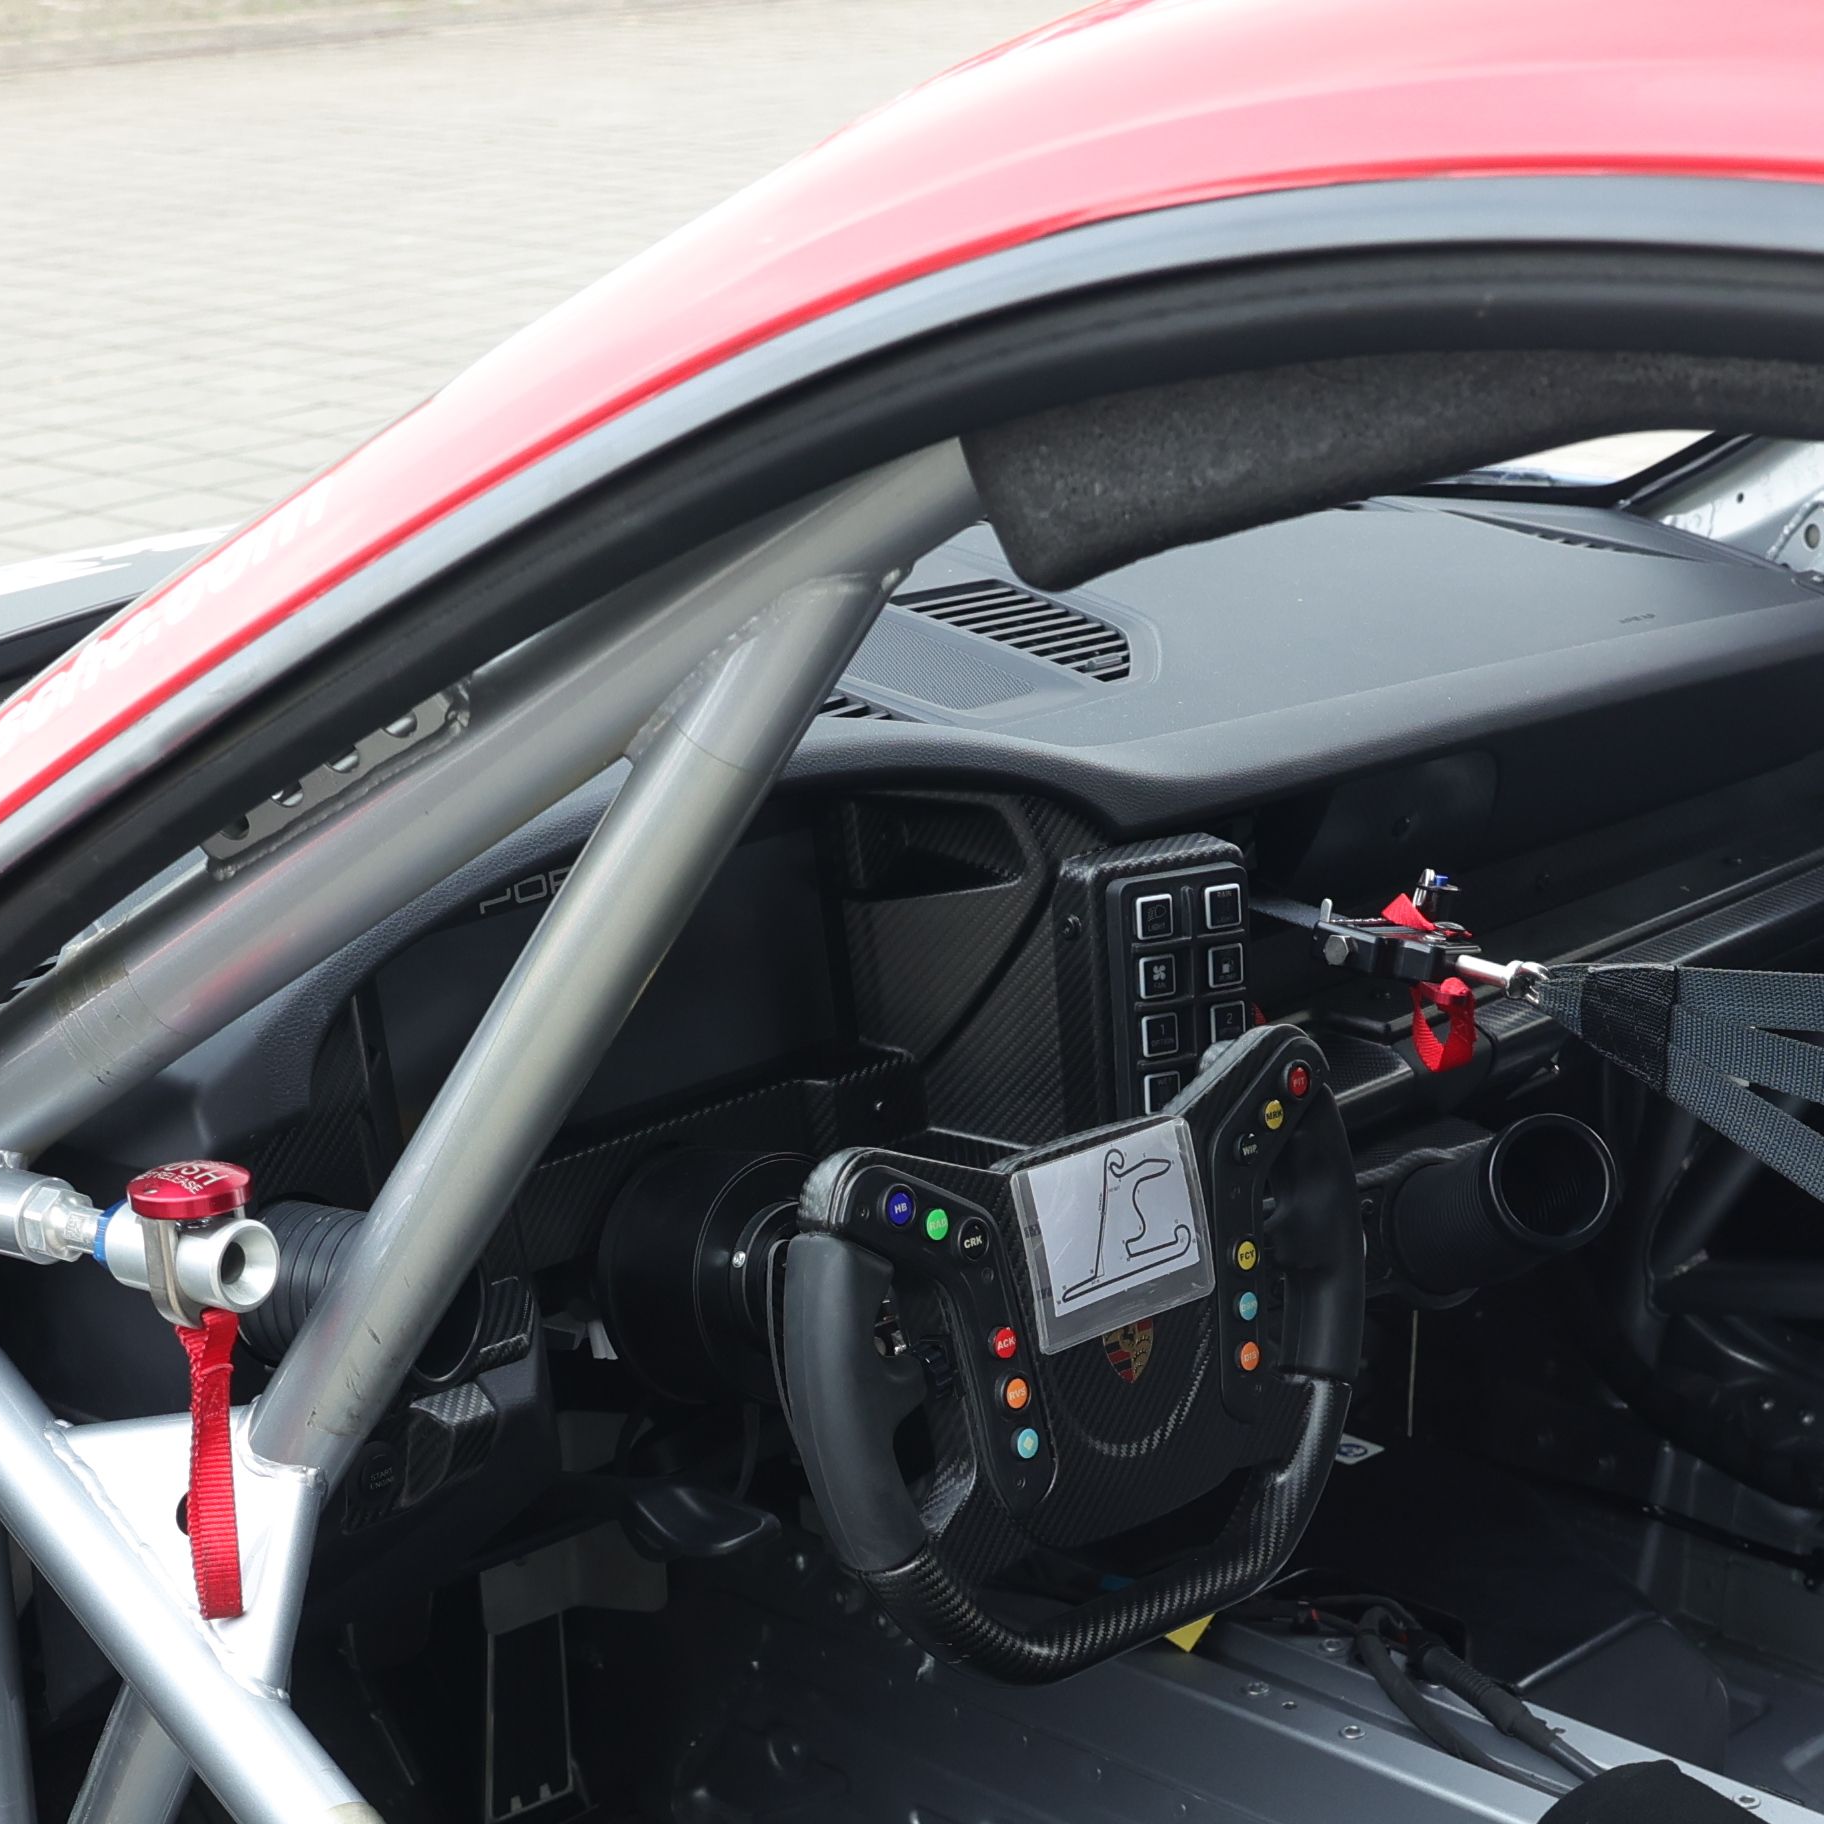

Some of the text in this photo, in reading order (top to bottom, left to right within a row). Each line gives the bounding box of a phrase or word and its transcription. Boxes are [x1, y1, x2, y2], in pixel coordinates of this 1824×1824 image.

[1266, 1109, 1283, 1121] MRK
[894, 1202, 908, 1214] HB
[963, 1235, 983, 1249] CRK
[1239, 1250, 1255, 1261] FCY
[997, 1337, 1016, 1351] ACK
[1008, 1387, 1028, 1401] RVS
